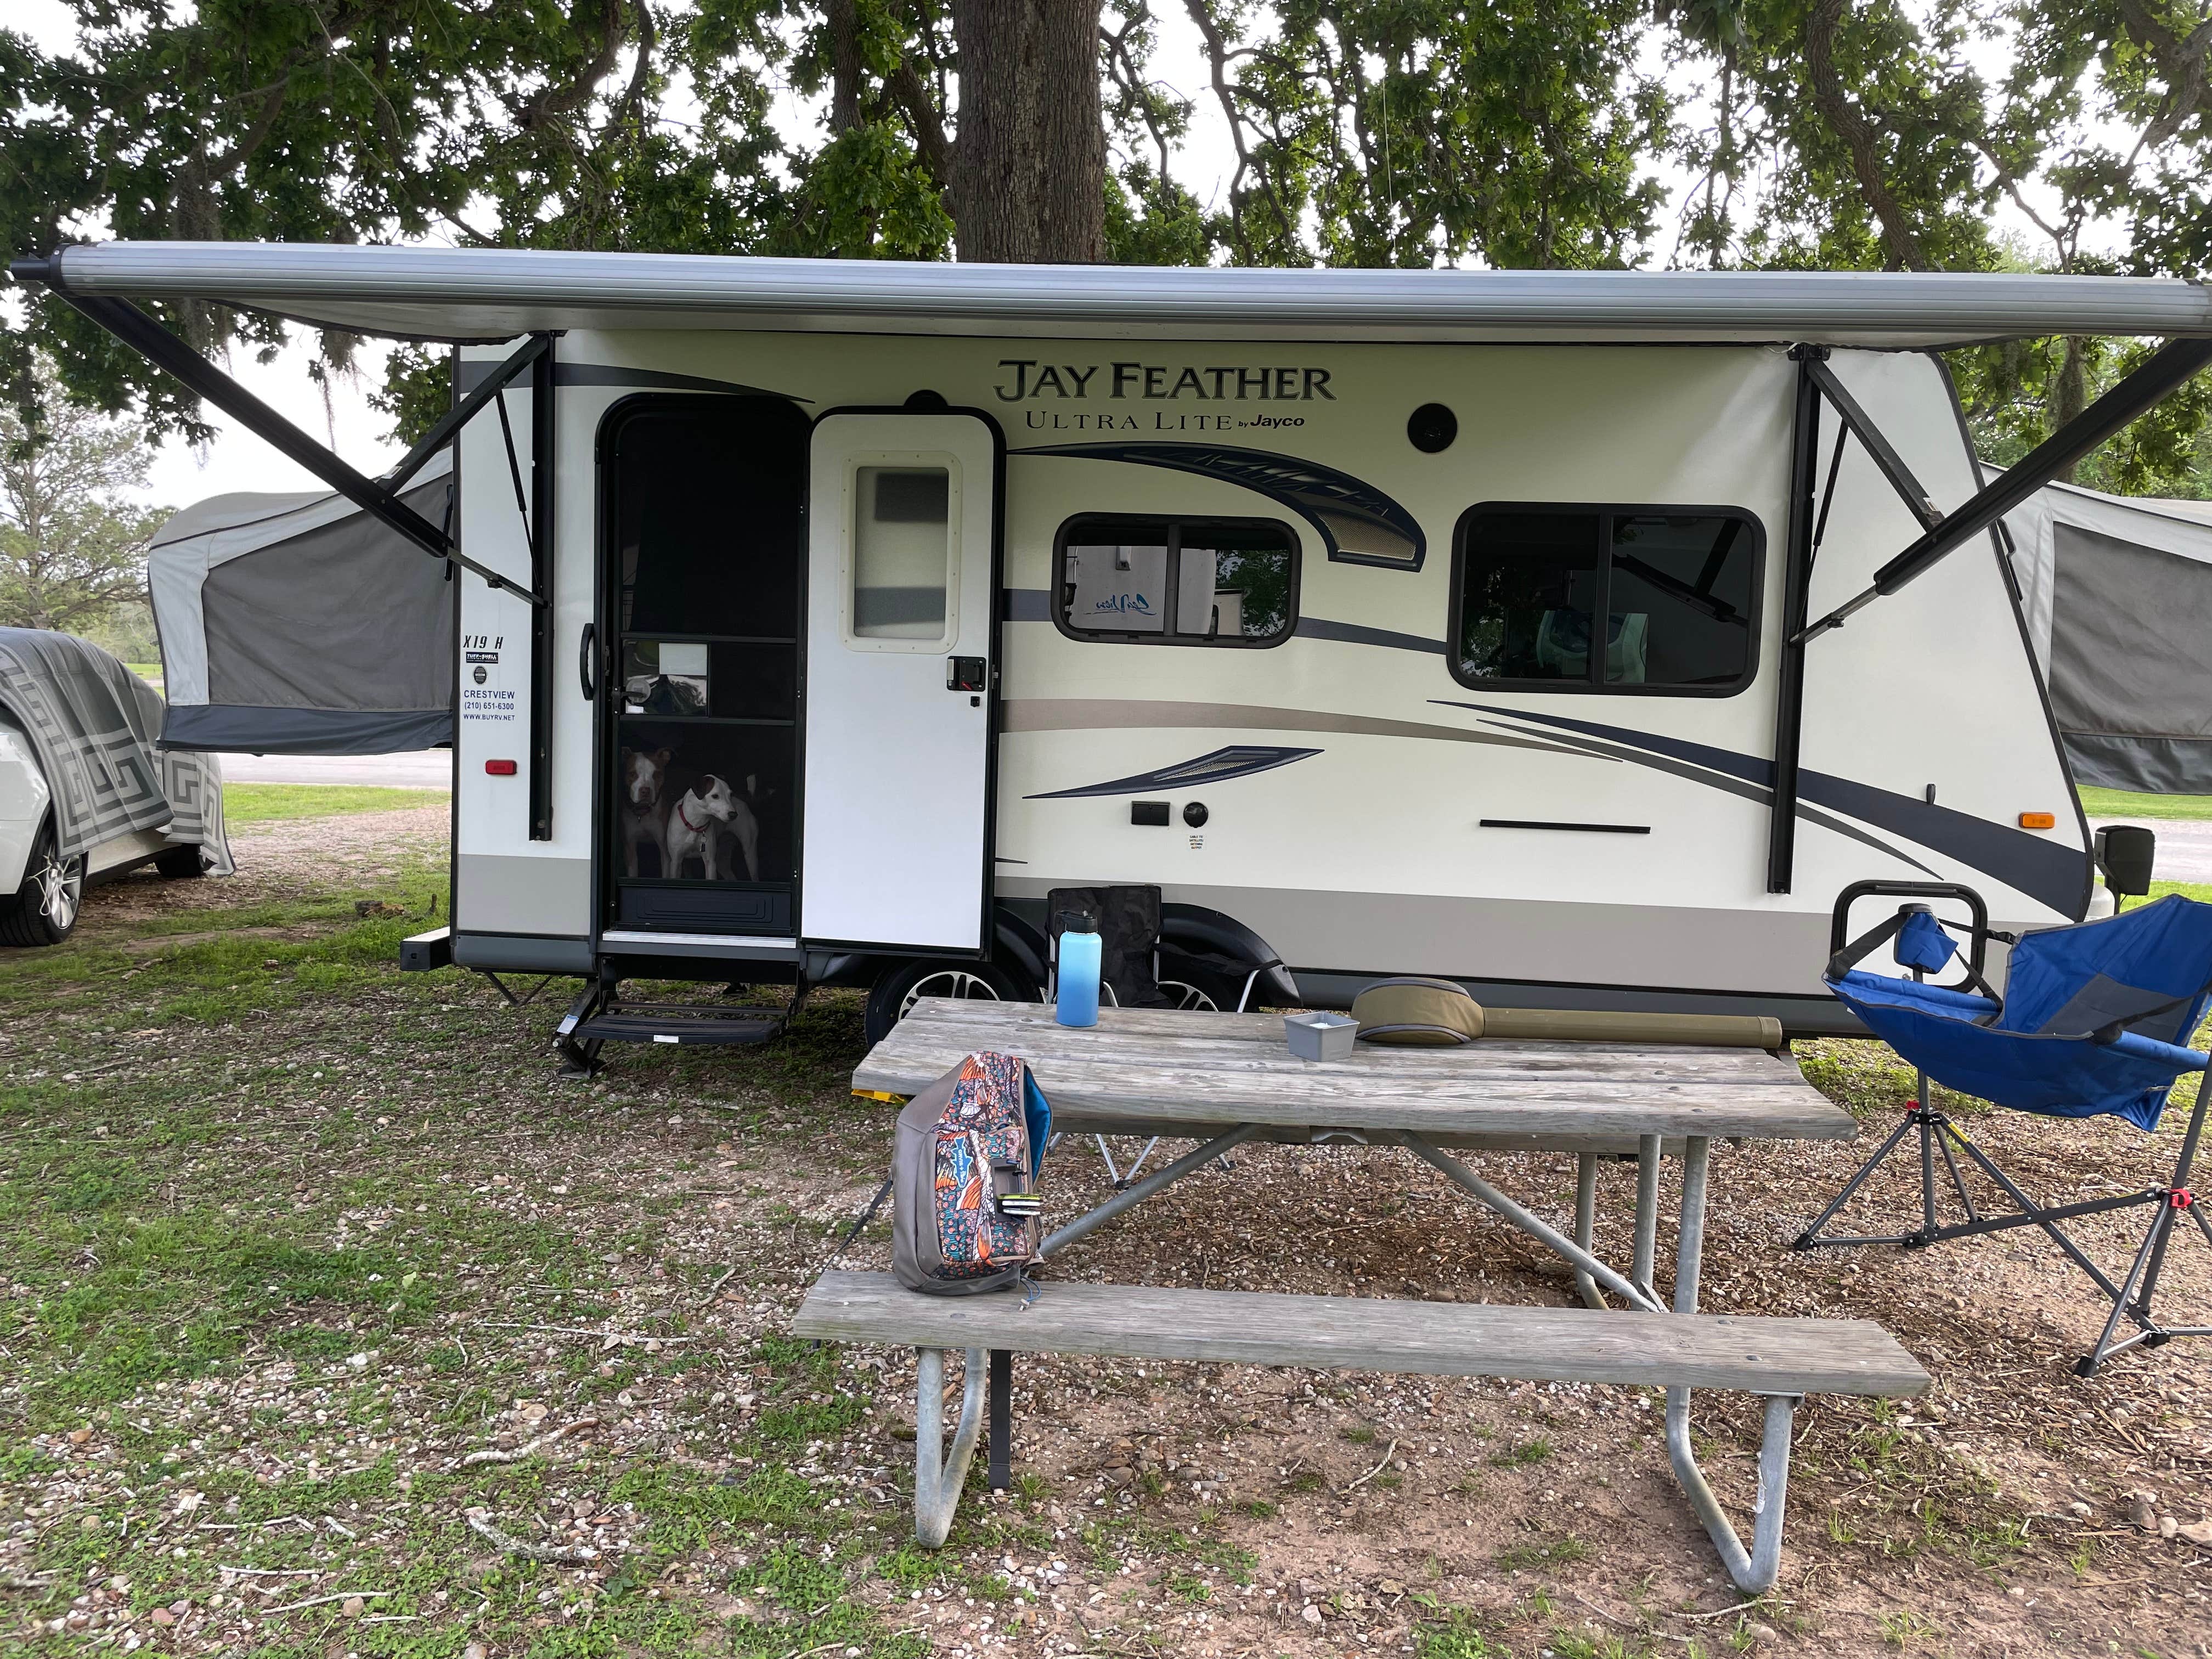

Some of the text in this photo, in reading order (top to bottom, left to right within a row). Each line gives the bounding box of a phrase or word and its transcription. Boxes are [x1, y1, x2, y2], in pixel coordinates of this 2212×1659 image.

[993, 359, 1337, 402] JAY FEATHER
[1026, 411, 1139, 430] ULTRA
[1155, 411, 1232, 430] LITE
[1249, 414, 1305, 428] Jayco
[495, 636, 504, 649] H
[464, 690, 515, 699] CRESTVIEW
[465, 702, 481, 710] (210)
